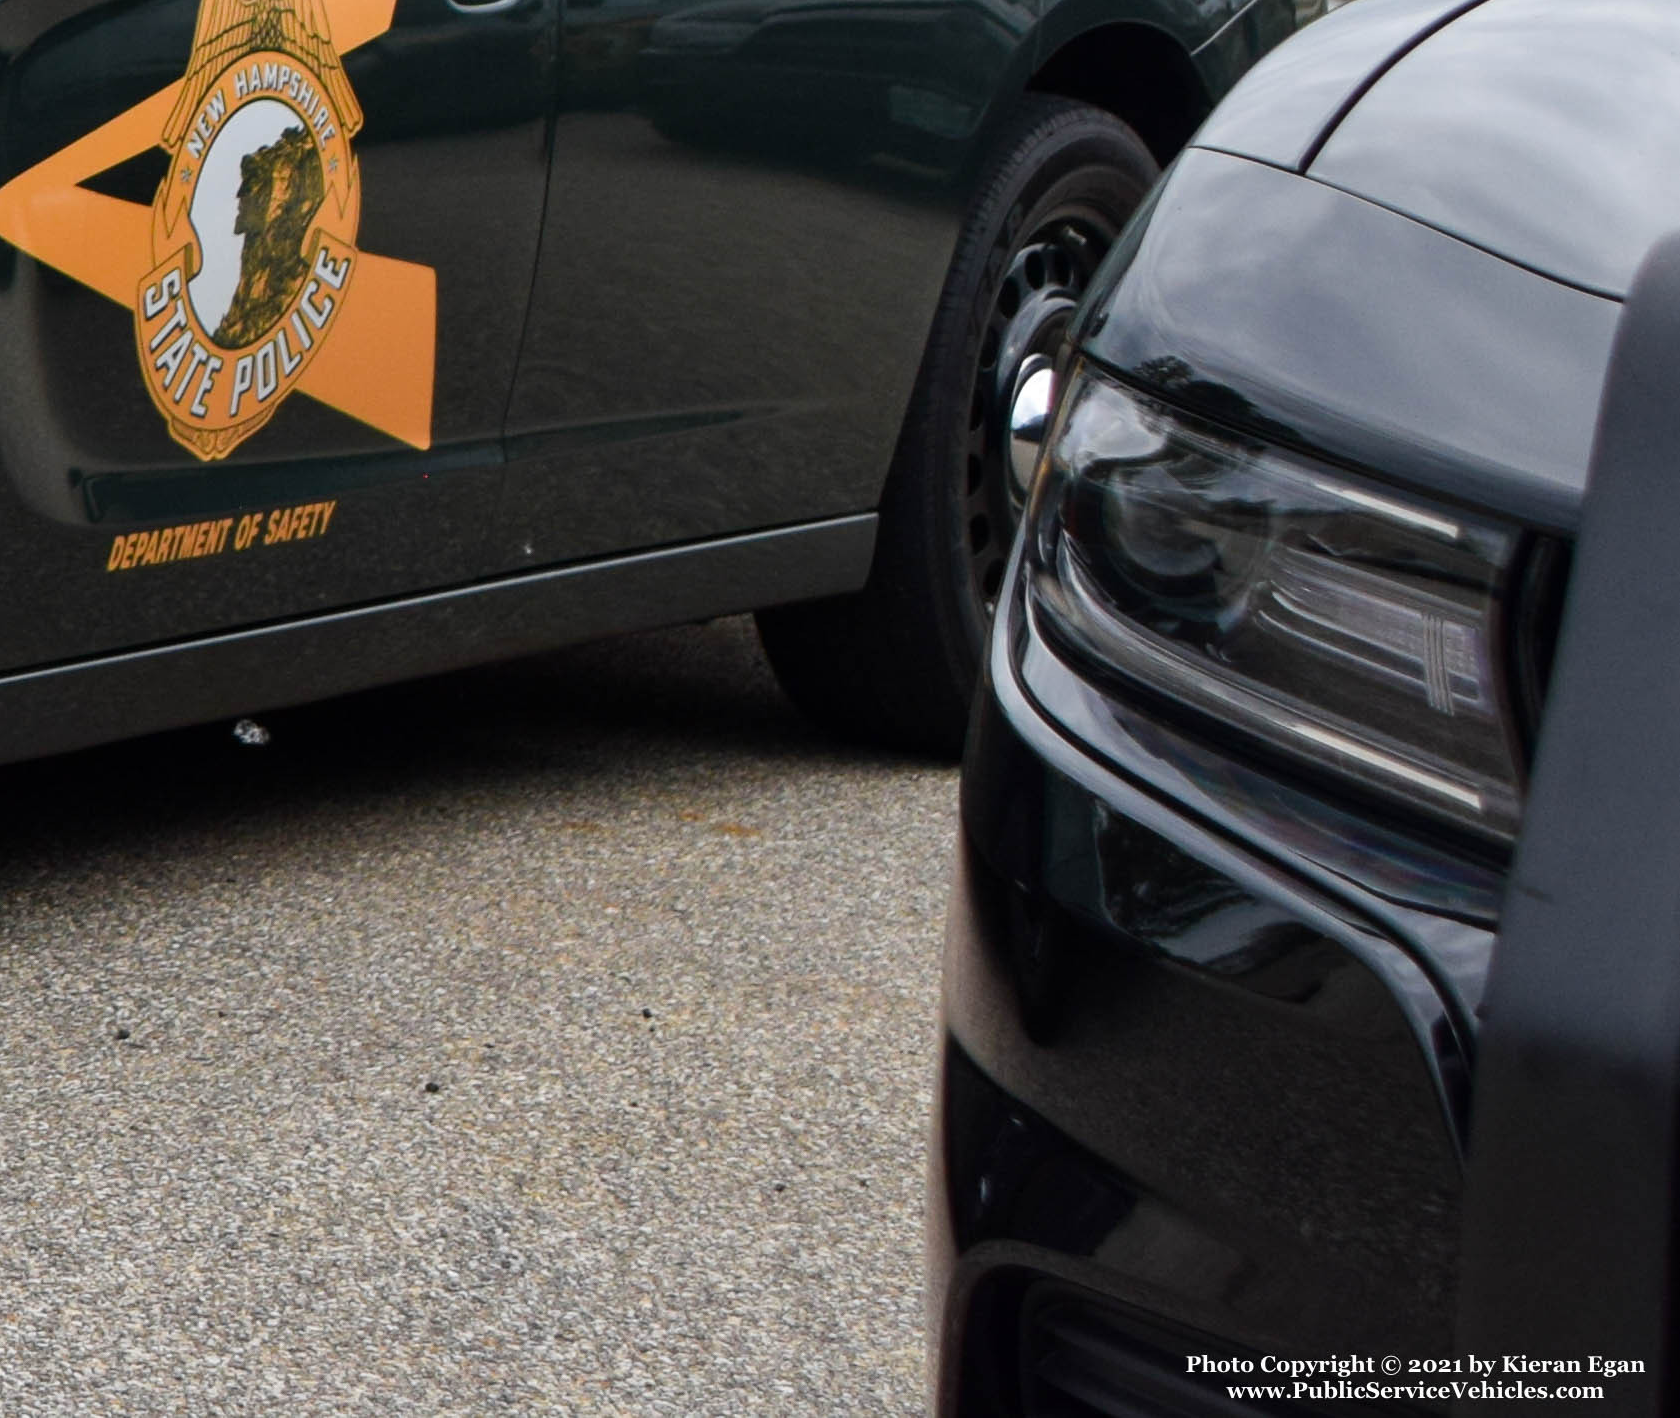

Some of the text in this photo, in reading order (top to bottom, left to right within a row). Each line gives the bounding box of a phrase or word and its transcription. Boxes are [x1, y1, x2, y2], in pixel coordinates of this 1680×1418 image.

[187, 62, 336, 159] NEW HAMPSHIRE
[145, 246, 351, 418] STATE POLICE
[108, 501, 337, 572] DEPARTMENT OF SAFETY
